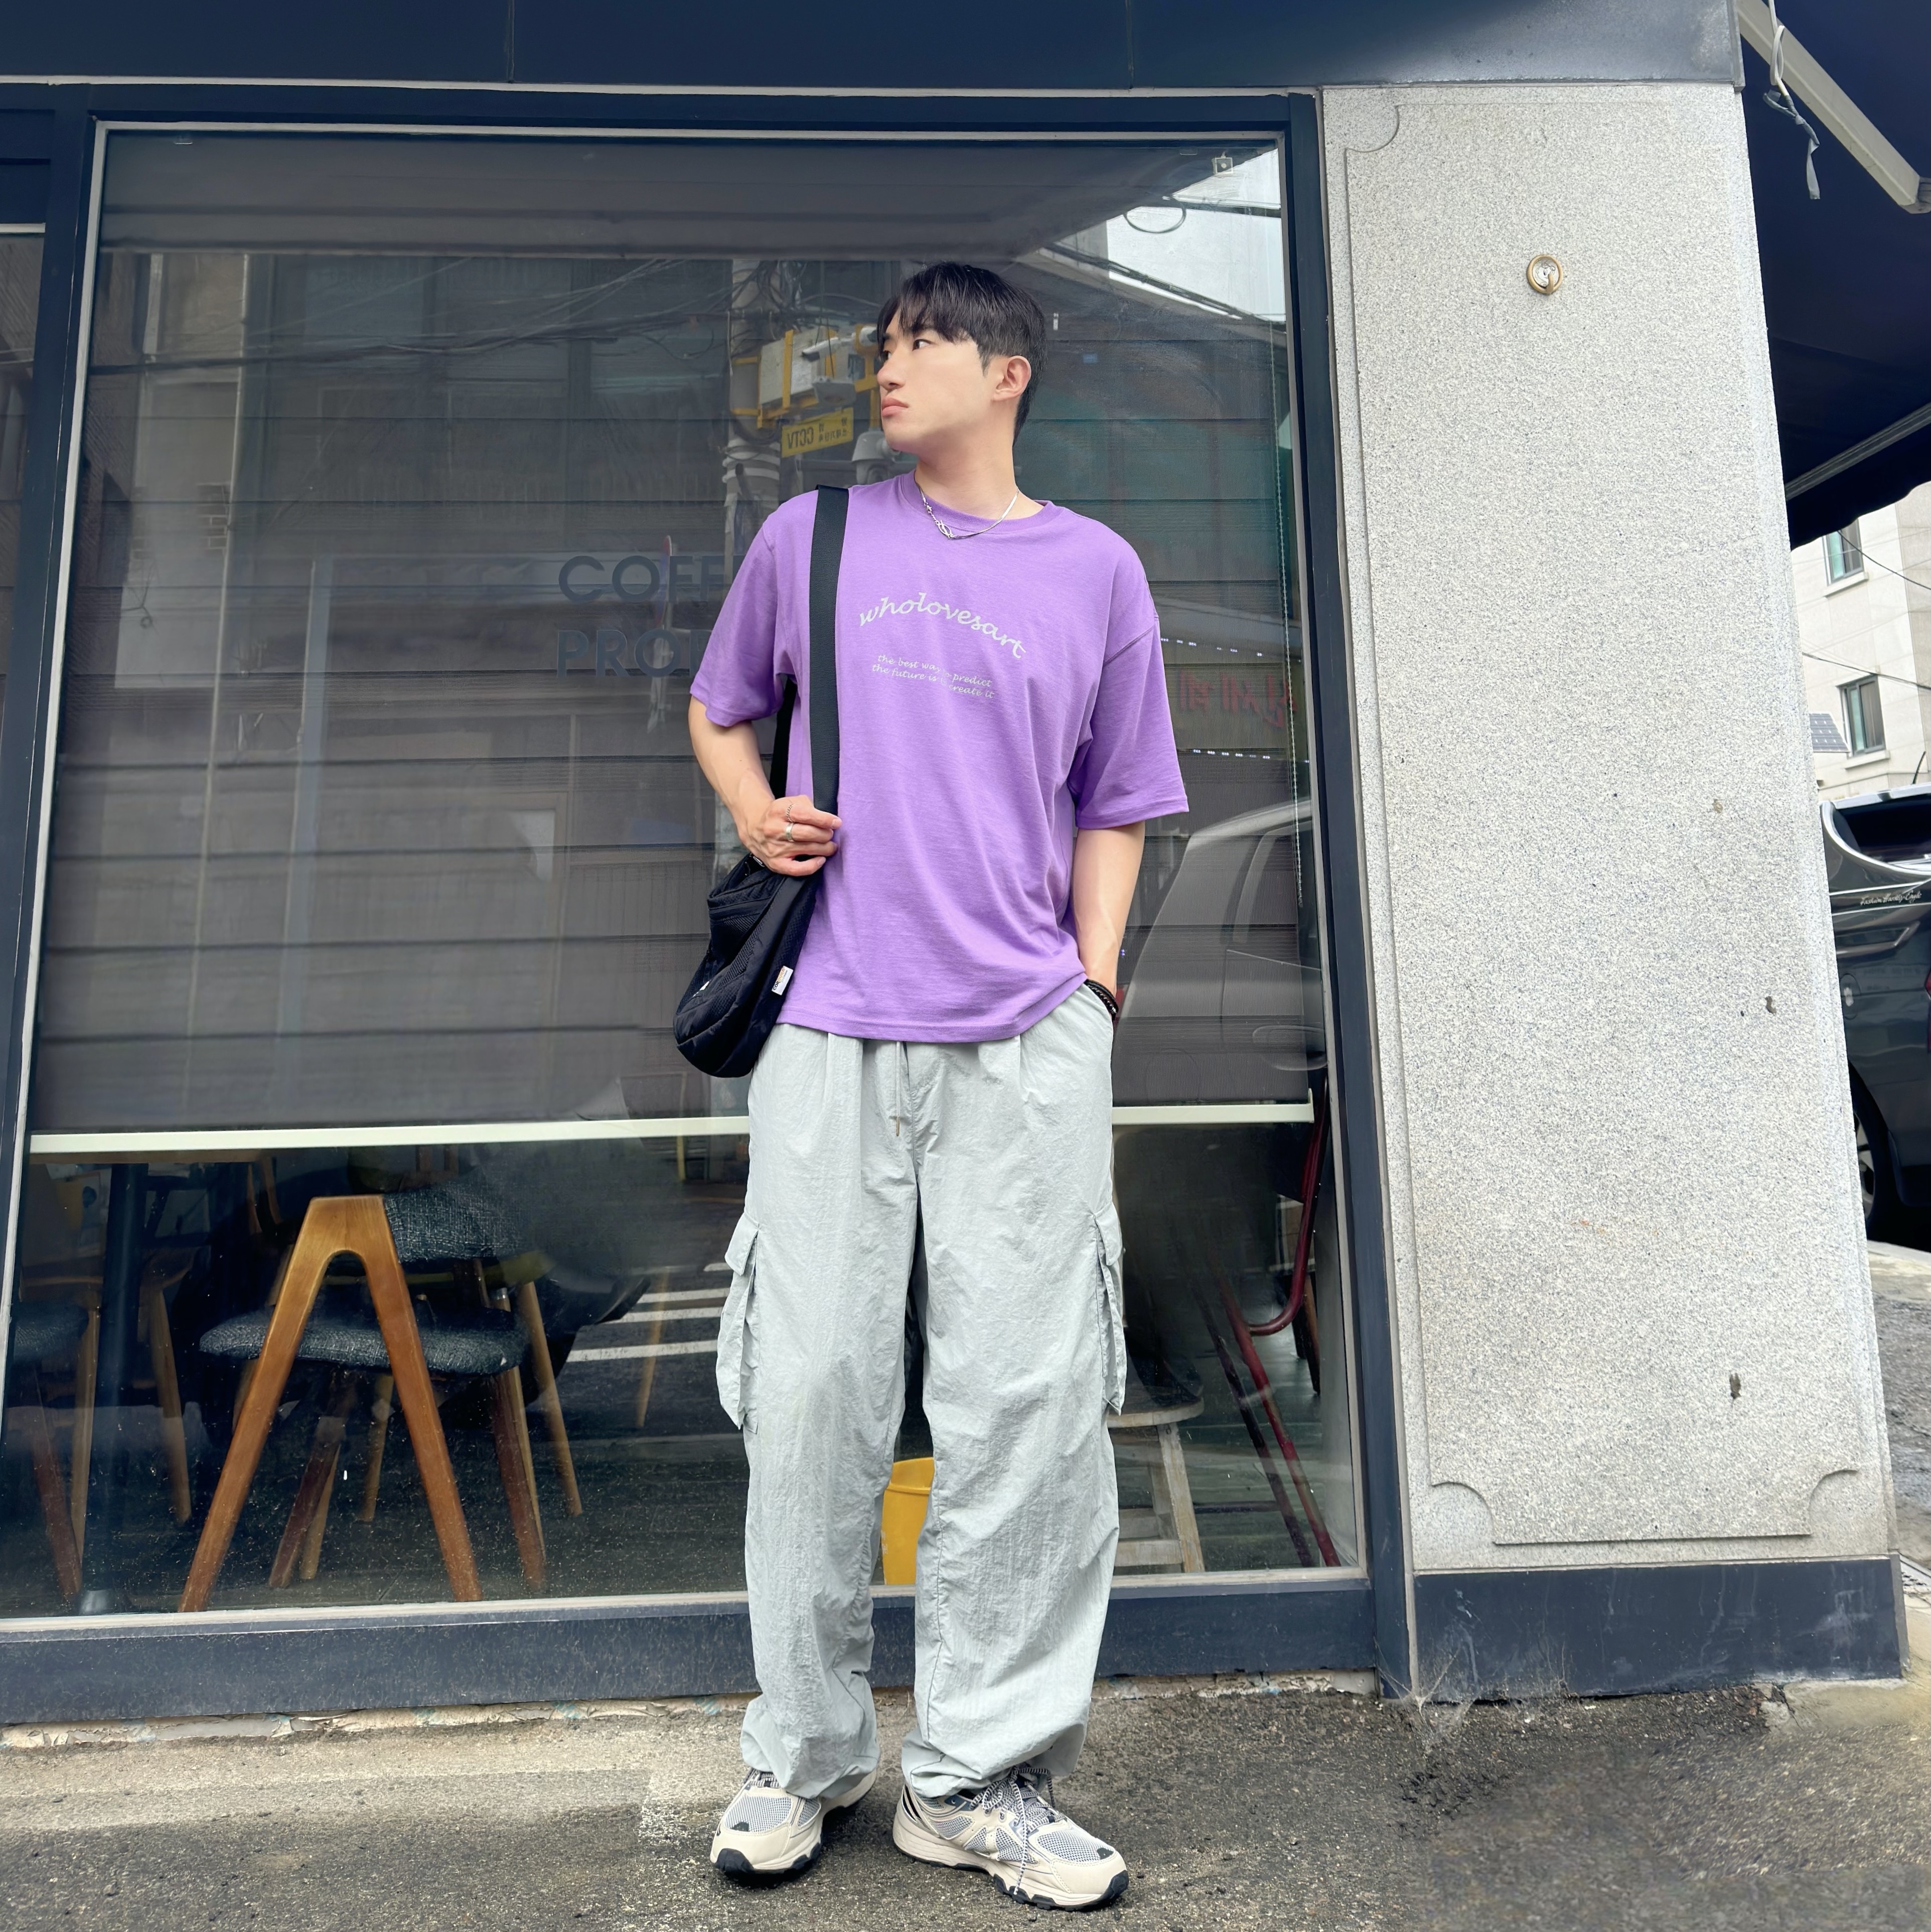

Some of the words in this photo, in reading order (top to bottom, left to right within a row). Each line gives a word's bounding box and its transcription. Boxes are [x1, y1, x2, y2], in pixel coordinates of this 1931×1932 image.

[859, 592, 1027, 659] wholovesart
[872, 663, 889, 674] the
[892, 666, 927, 680] future
[928, 673, 937, 681] is
[949, 684, 982, 697] create
[985, 689, 995, 699] it
[877, 654, 896, 665] the
[898, 656, 920, 668] best
[921, 661, 941, 673] way
[952, 673, 992, 687] predict
